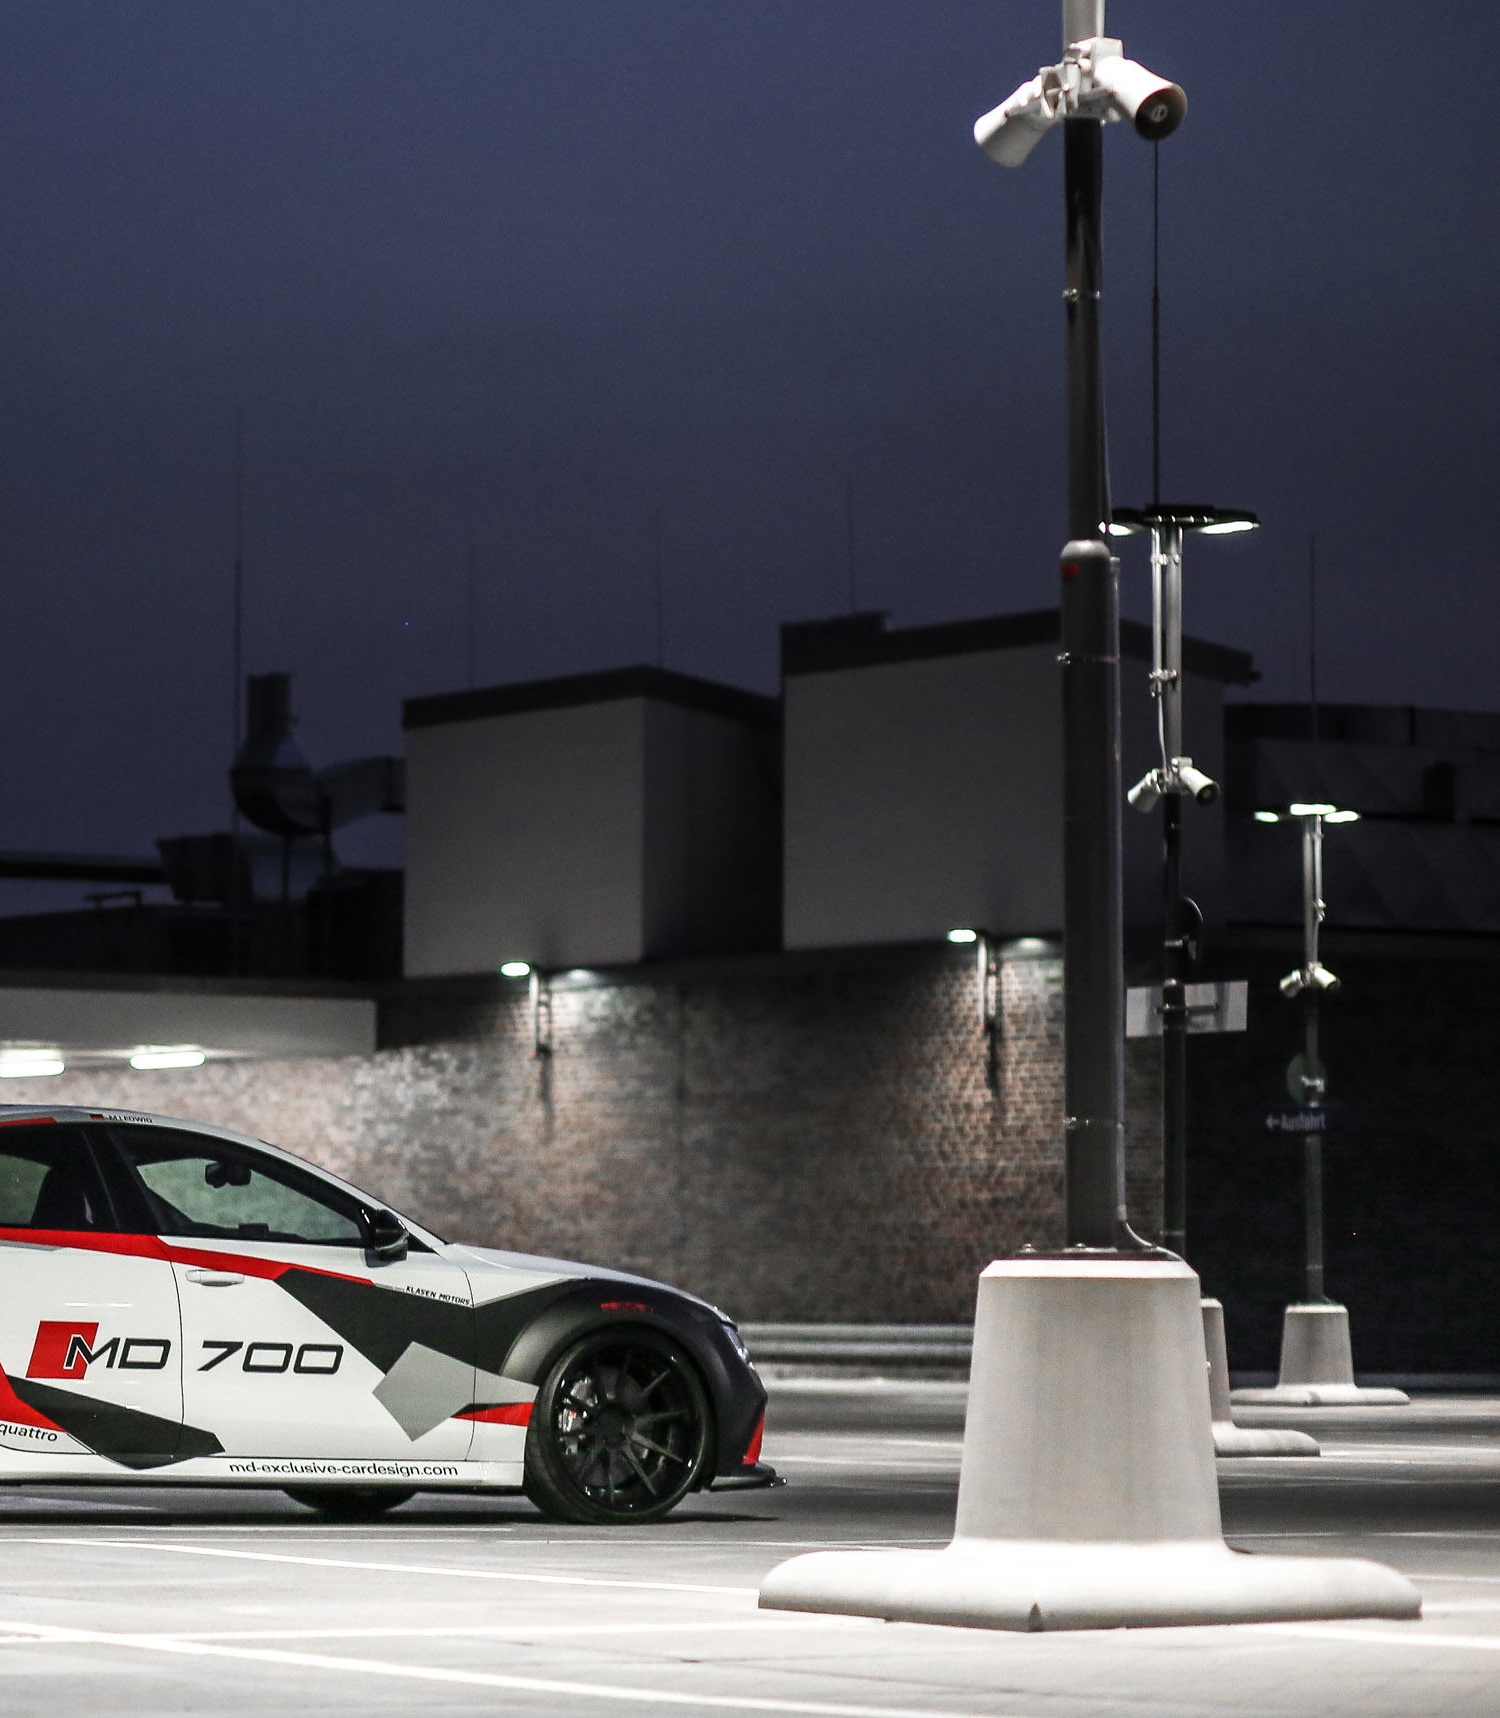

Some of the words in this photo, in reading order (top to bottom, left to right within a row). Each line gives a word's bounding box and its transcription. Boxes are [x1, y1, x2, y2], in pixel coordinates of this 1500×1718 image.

[439, 1293, 470, 1305] MOTORS
[64, 1335, 172, 1369] MD
[197, 1340, 344, 1375] 700
[229, 1462, 458, 1477] md-exclusive-cardesign.com
